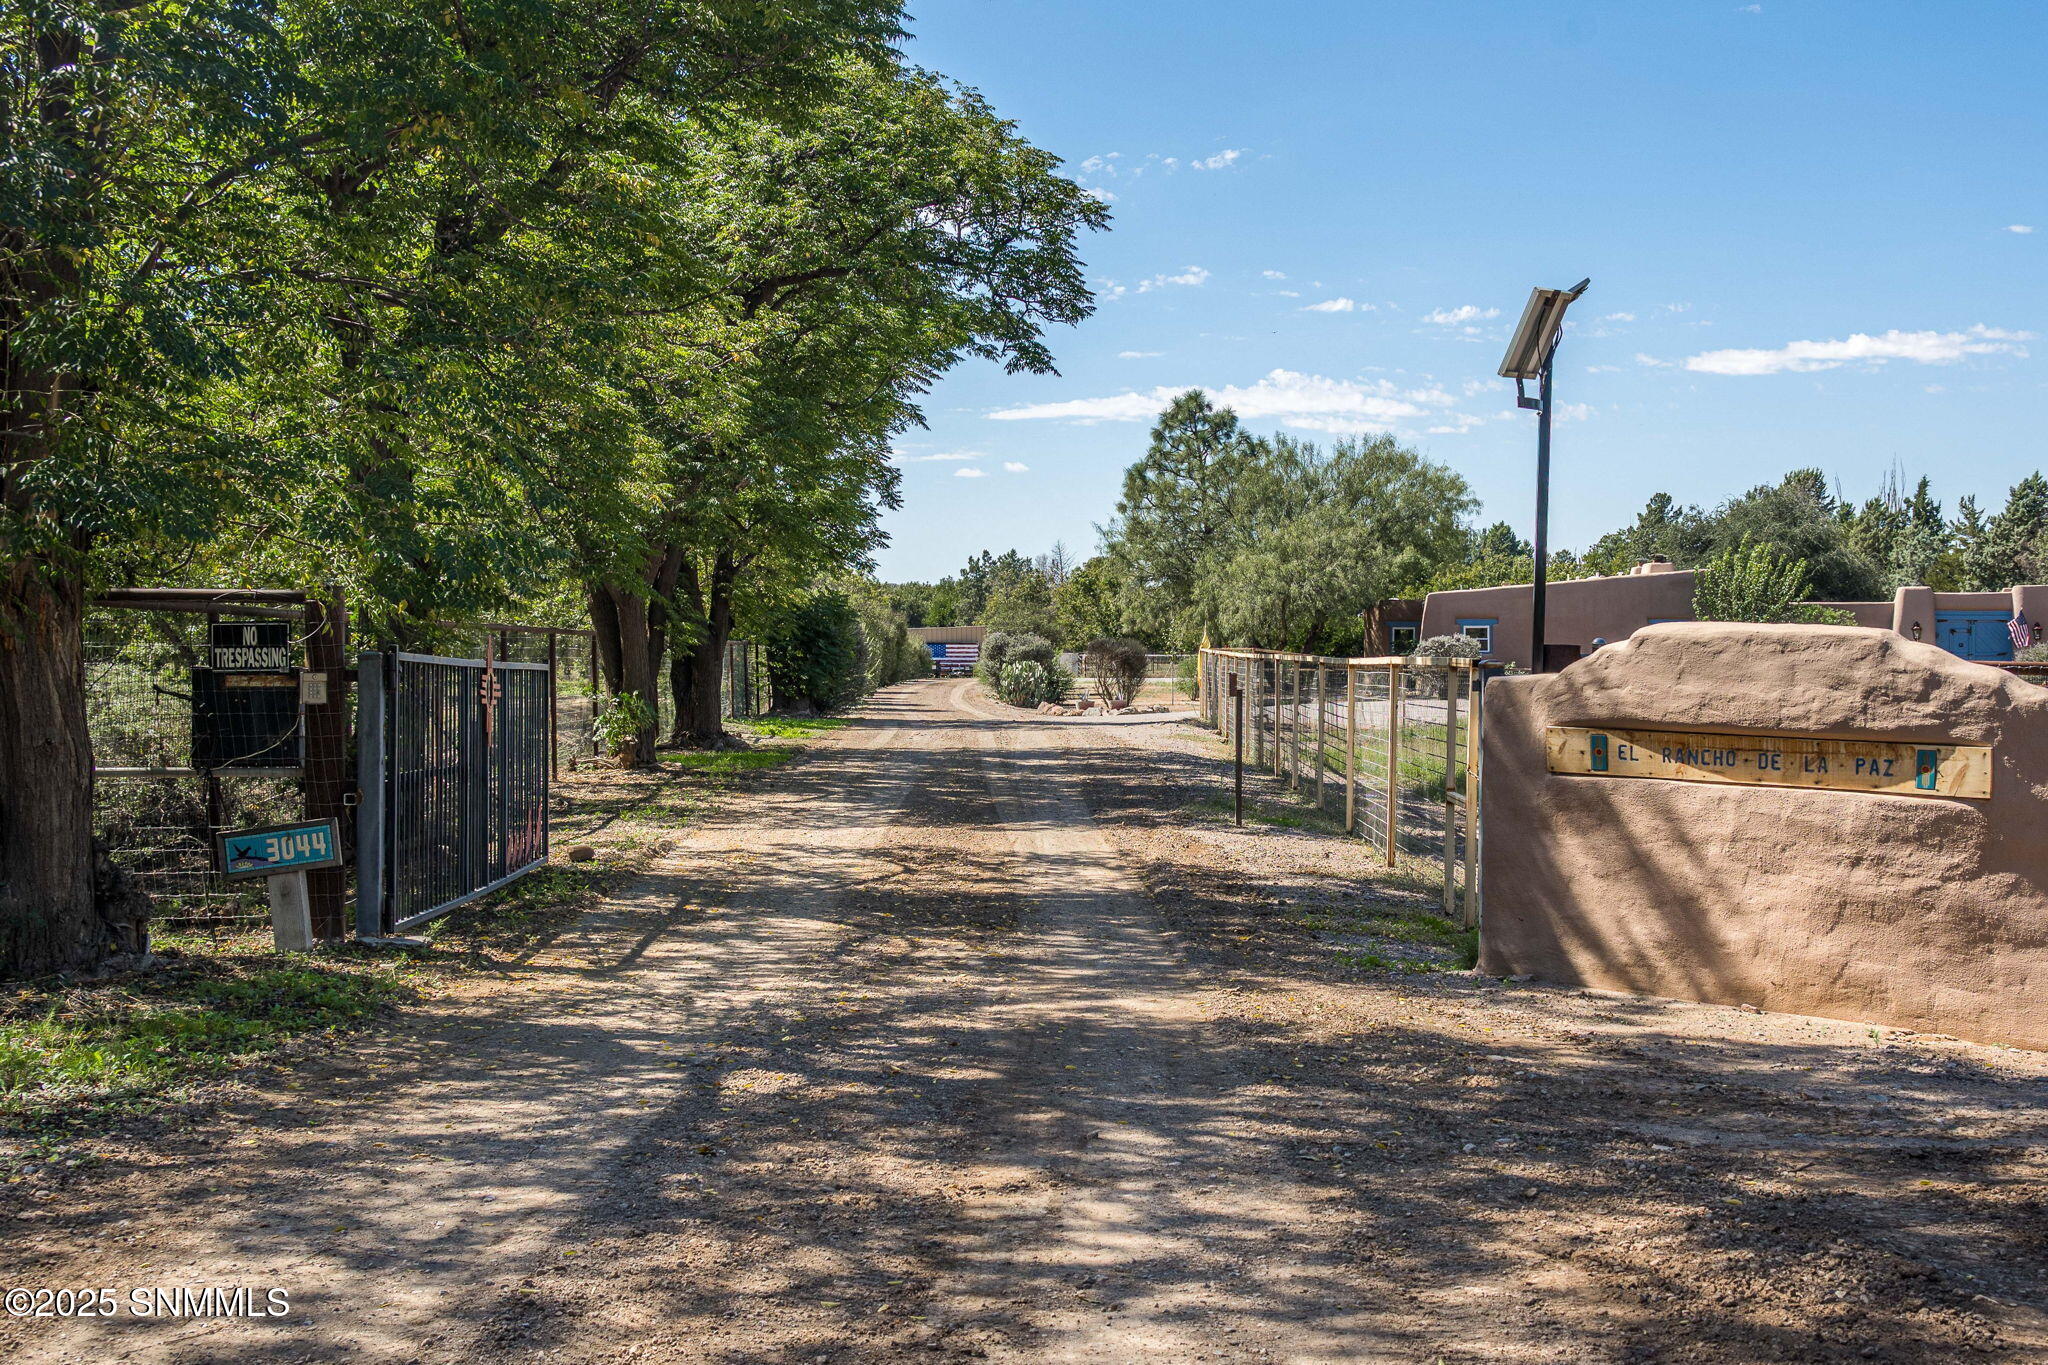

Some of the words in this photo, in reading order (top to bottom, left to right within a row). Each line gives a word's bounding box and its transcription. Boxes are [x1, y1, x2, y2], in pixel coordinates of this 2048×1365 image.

[242, 626, 258, 646] NO
[214, 647, 287, 668] TRESPASSING
[1617, 744, 1639, 761] EL
[1662, 747, 1736, 767] RANCHO
[1758, 752, 1781, 770] DE
[1804, 755, 1828, 773] LA
[1855, 757, 1894, 777] PAZ
[266, 832, 326, 862] 3044
